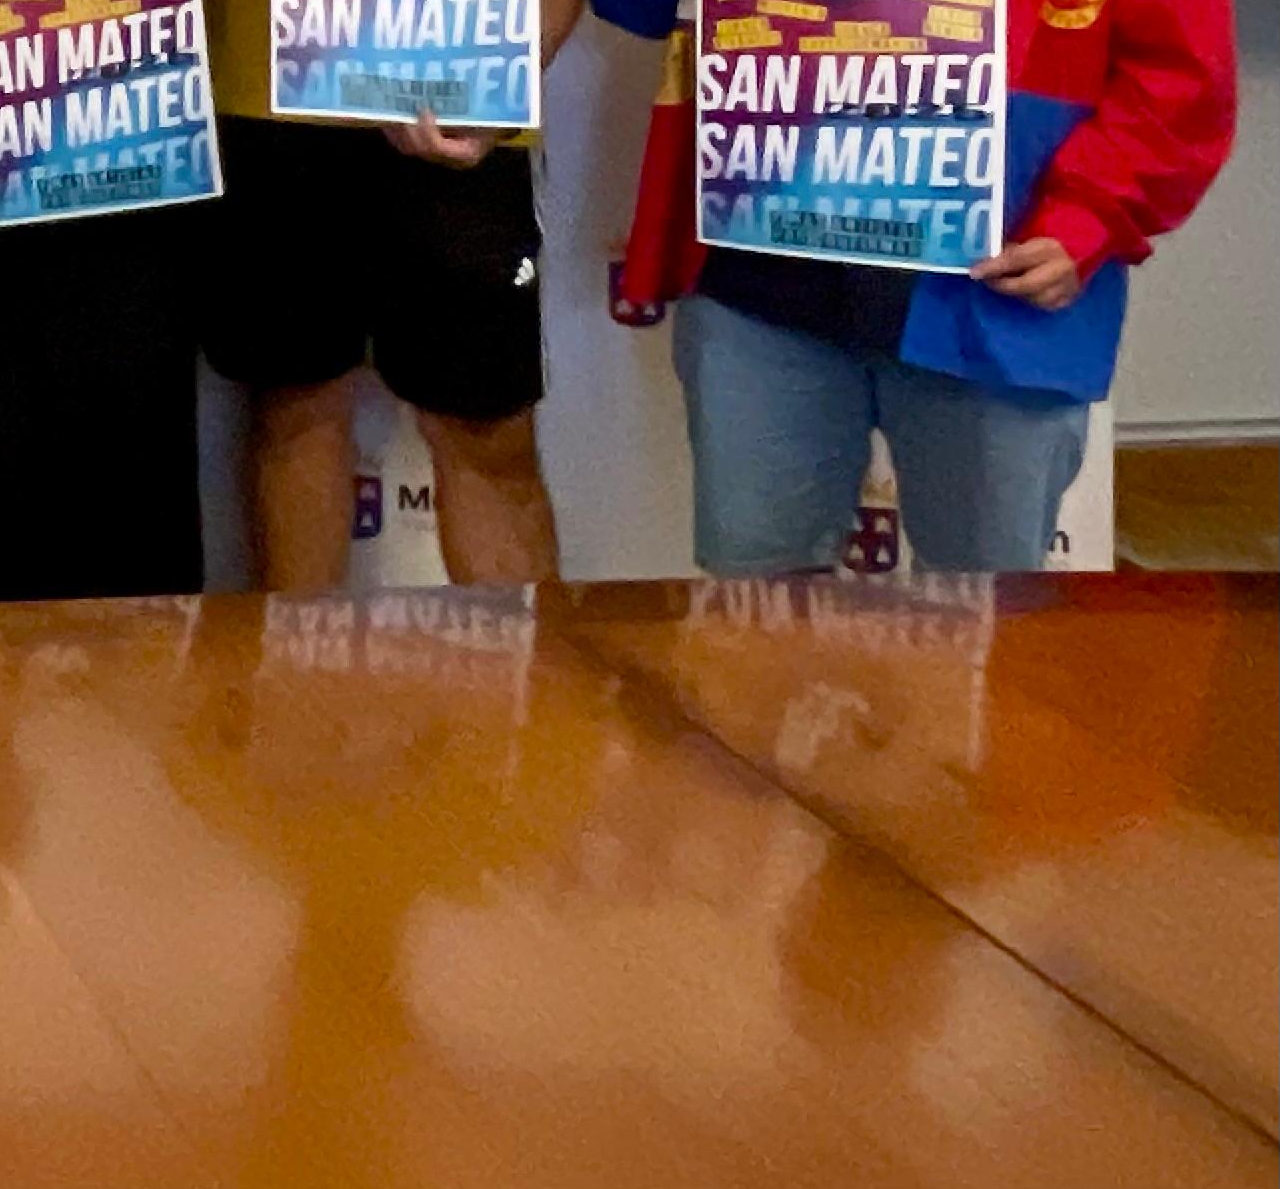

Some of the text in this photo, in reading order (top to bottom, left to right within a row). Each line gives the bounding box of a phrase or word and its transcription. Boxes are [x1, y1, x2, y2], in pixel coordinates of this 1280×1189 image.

[58, 2, 200, 83] MATEO
[65, 66, 208, 147] MATEO
[699, 54, 996, 115] SAN MATEO
[700, 124, 994, 188] SAN MATEO
